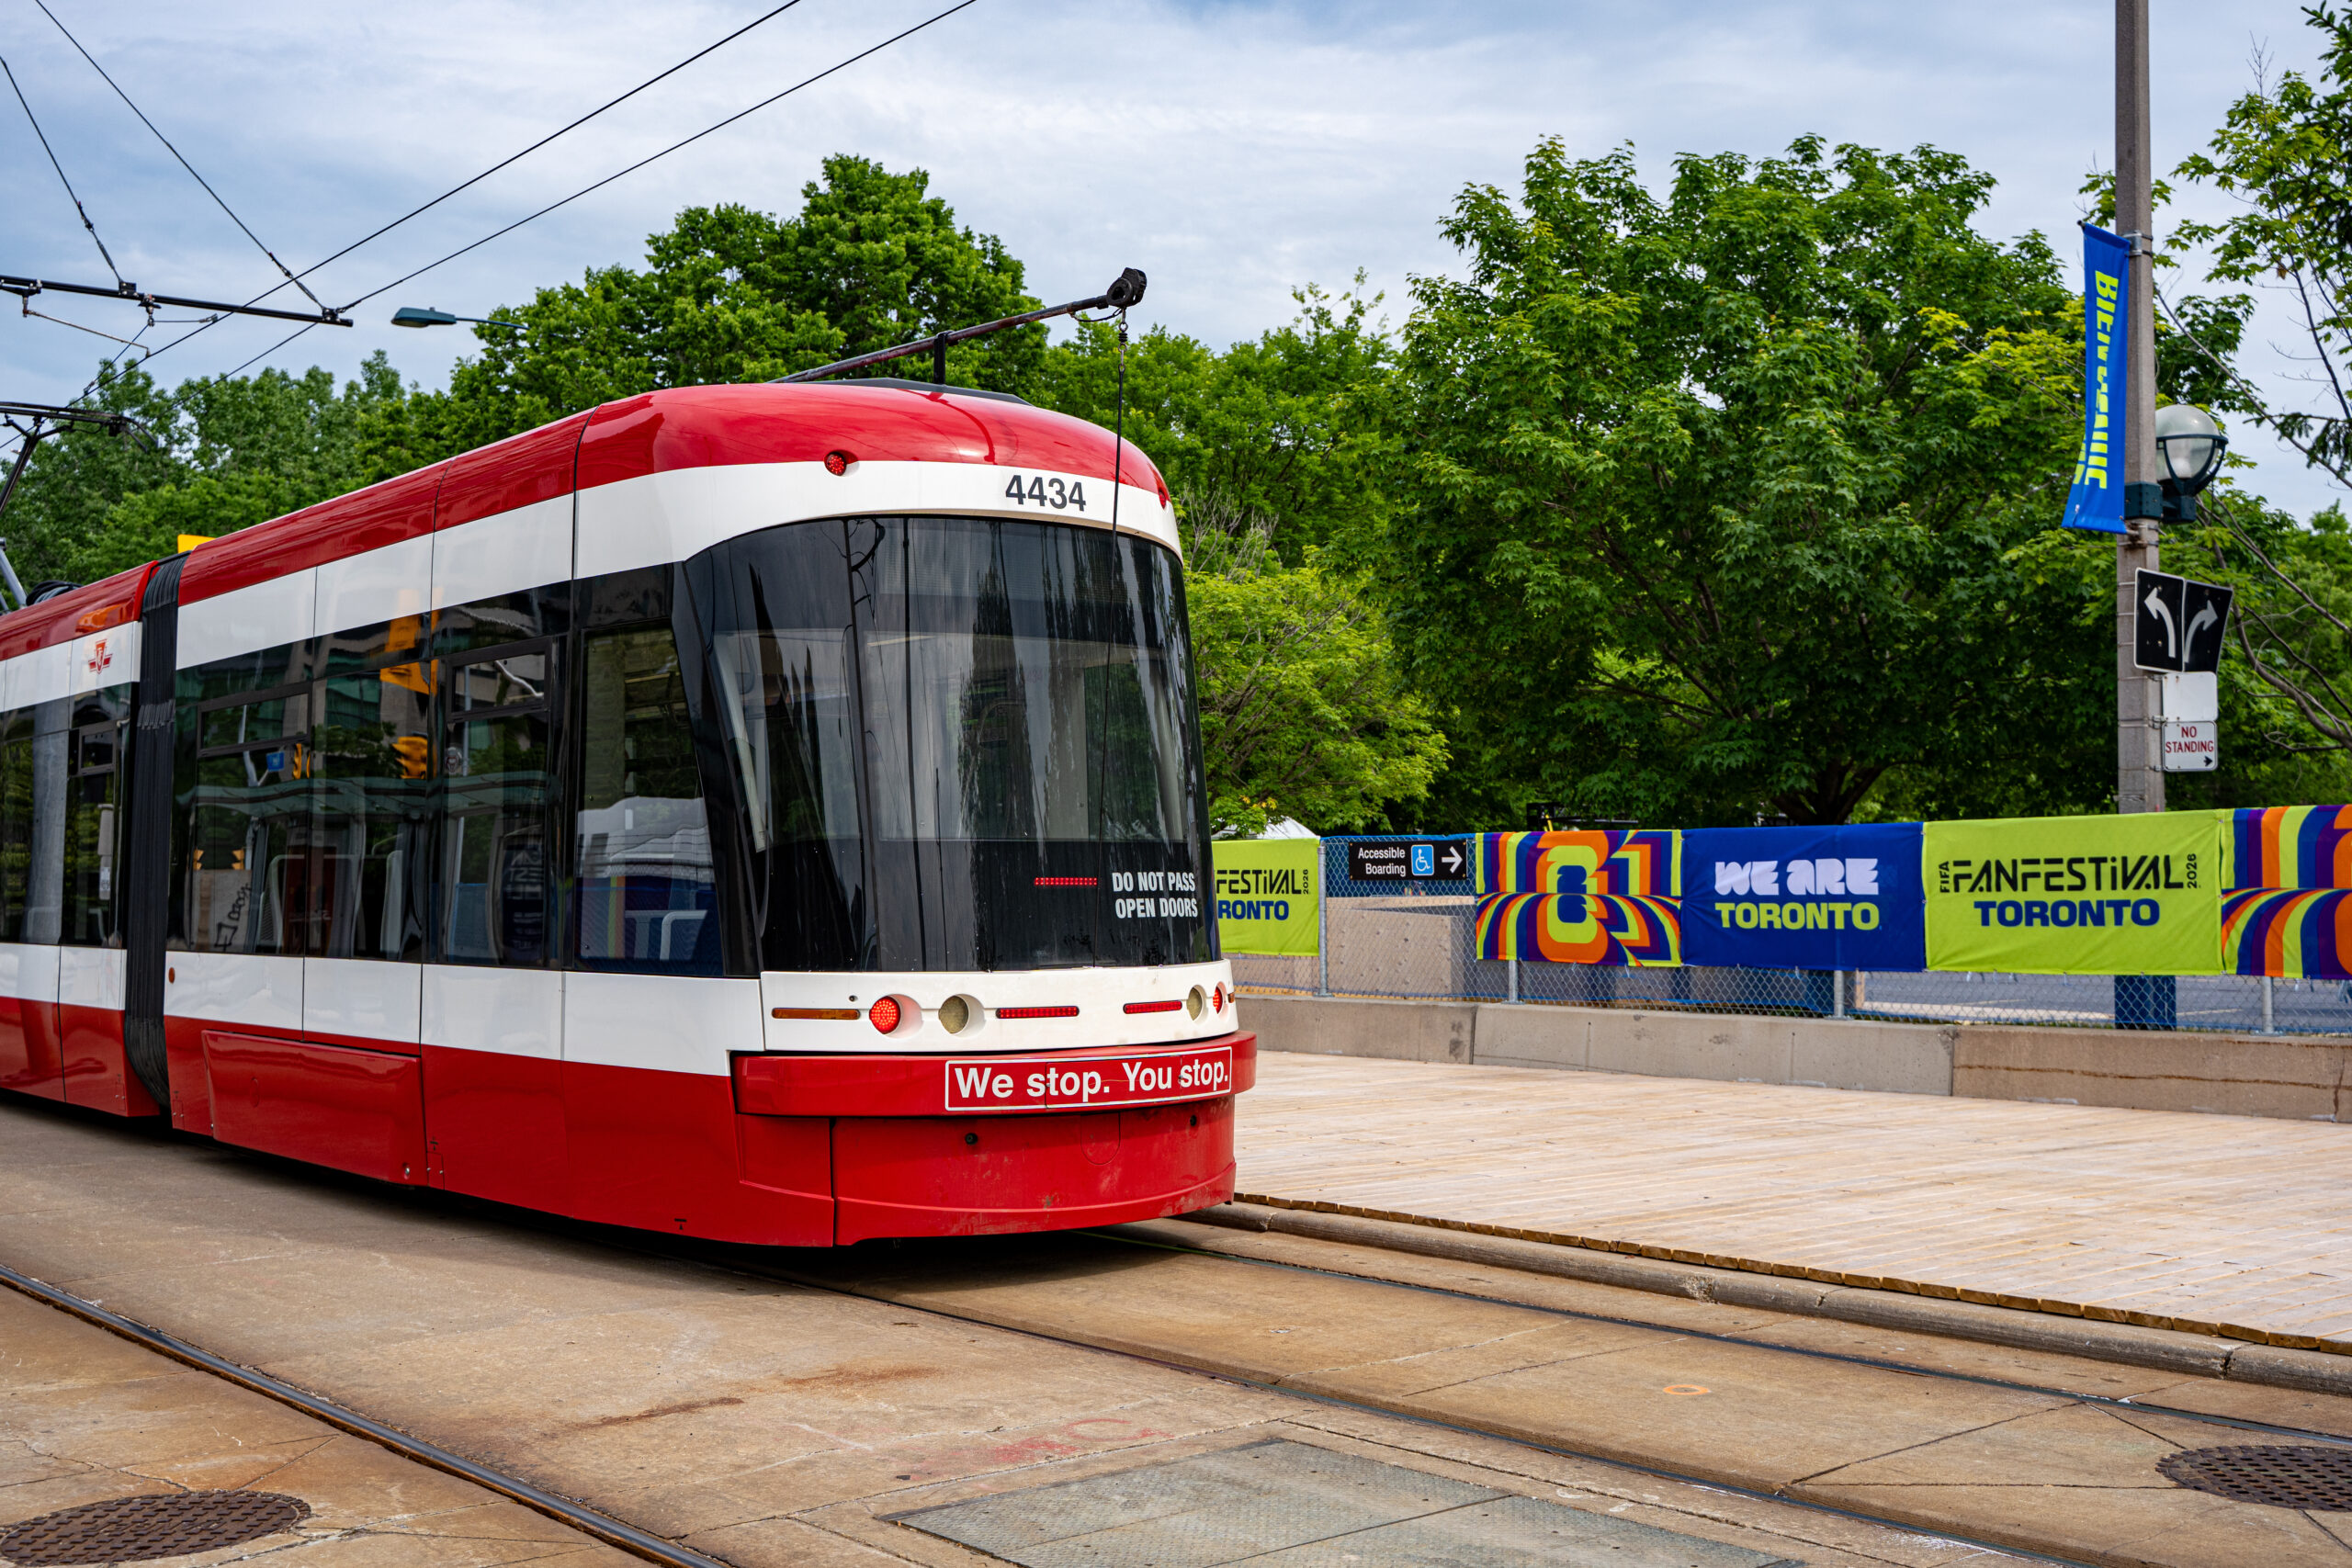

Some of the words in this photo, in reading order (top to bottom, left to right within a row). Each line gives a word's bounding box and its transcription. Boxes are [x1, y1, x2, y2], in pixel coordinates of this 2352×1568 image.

[1005, 474, 1087, 512] 4434
[2165, 739, 2214, 754] STANDING
[2181, 726, 2198, 739] NO
[1358, 846, 1406, 859] Accessible
[1112, 872, 1135, 892] DO
[1137, 871, 1165, 891] NOT
[1167, 872, 1196, 891] PASS
[1365, 863, 1406, 877] Boarding
[1714, 860, 1780, 896] WE
[1786, 858, 1879, 896] ARE
[1939, 861, 1951, 894] FIFA
[2186, 852, 2198, 889] 2026
[1114, 897, 1156, 919] OPEN
[1159, 897, 1199, 918] DOORS
[1714, 902, 1880, 931] TORONTO
[1973, 897, 2160, 928] TORONTO
[954, 1066, 1014, 1099] We
[1026, 1066, 1110, 1103] stop.
[1122, 1061, 1172, 1093] You
[1180, 1058, 1228, 1091] stop.
